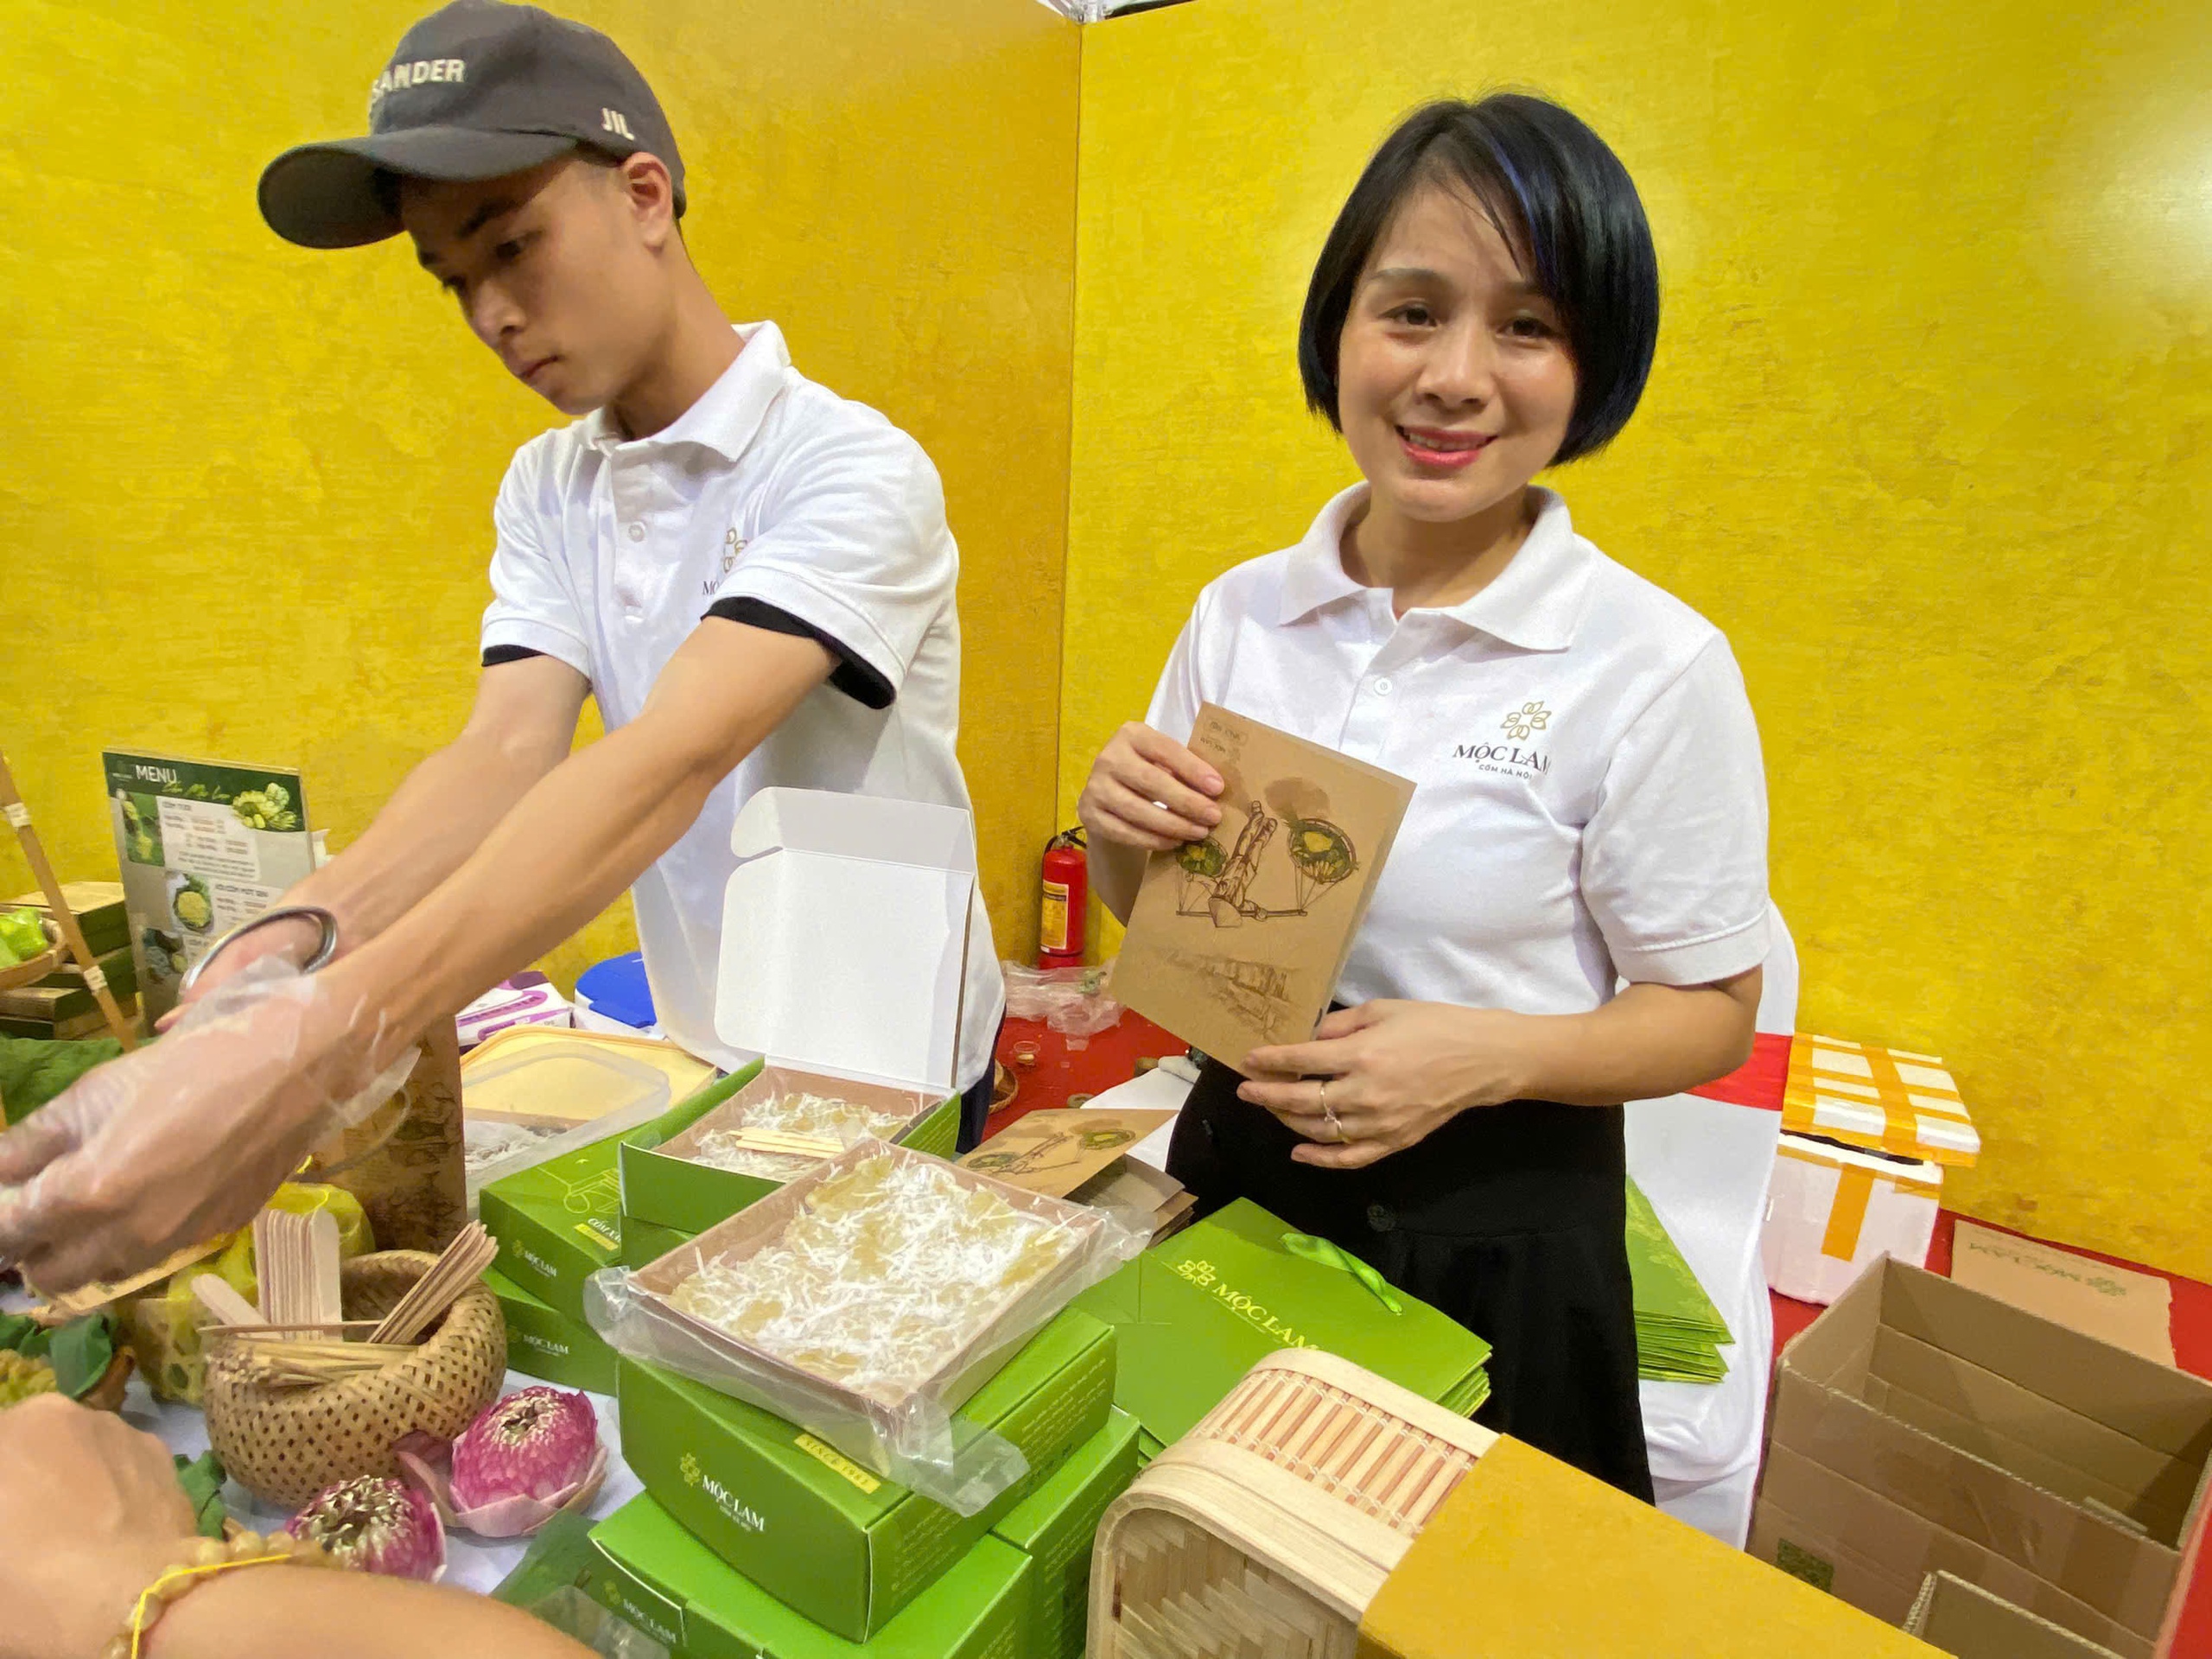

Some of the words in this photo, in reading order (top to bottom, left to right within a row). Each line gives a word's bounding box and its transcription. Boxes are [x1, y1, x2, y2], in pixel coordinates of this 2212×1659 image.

[601, 107, 635, 141] JIL
[1452, 742, 1508, 764] MỘC
[135, 764, 177, 784] MENU
[1212, 1282, 1268, 1320] MỘC
[702, 1474, 734, 1506] MỘC
[733, 1497, 766, 1533] LAM
